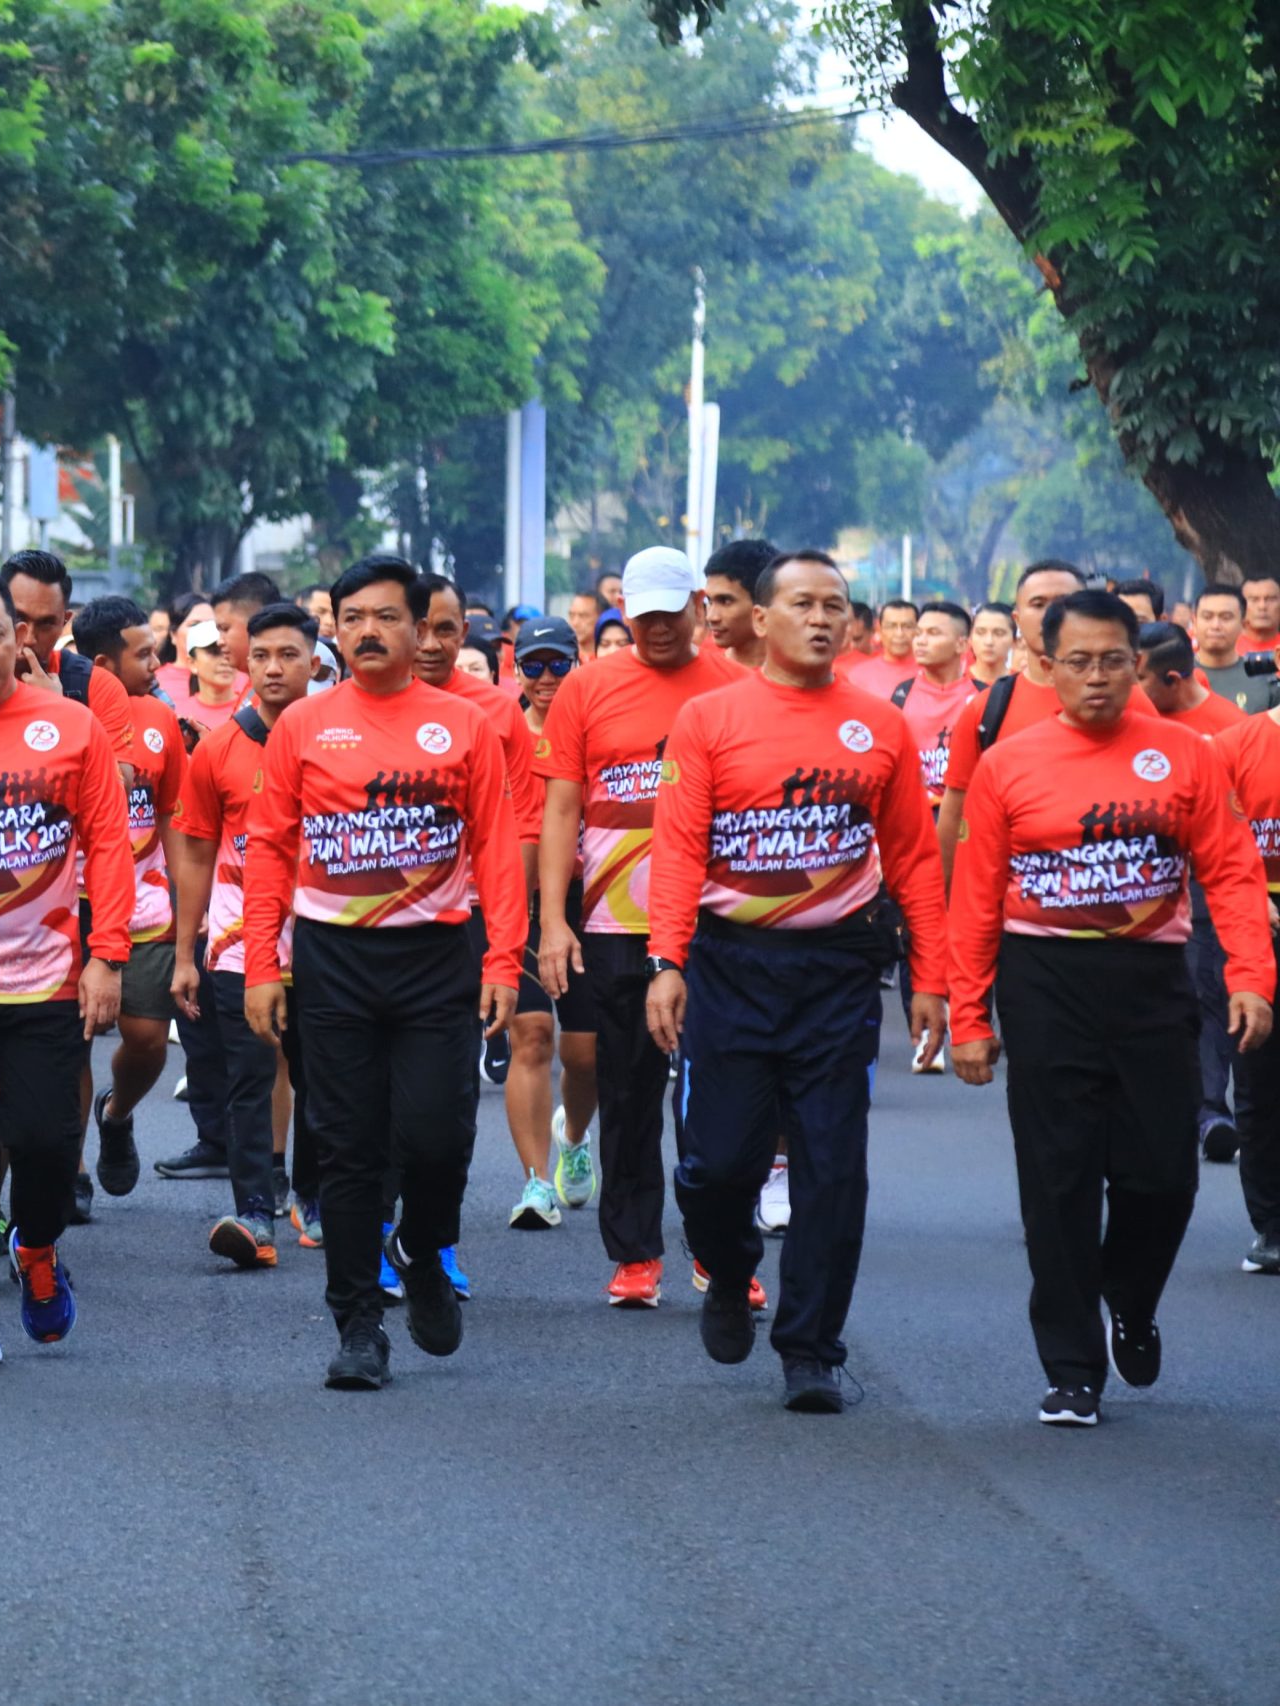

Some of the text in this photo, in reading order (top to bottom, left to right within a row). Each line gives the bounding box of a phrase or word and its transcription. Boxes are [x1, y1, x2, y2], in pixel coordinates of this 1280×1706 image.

[608, 777, 635, 798] FUN
[310, 837, 342, 864] FUN
[351, 828, 421, 856] WALK
[712, 834, 750, 858] FUN
[756, 829, 833, 858] WALK
[327, 859, 377, 876] BERJALAN
[380, 854, 418, 869] DALAM
[730, 859, 782, 872] BERJALAN
[785, 855, 826, 870] DALAM
[1070, 860, 1146, 890] WALK
[1103, 890, 1143, 904] DALAM
